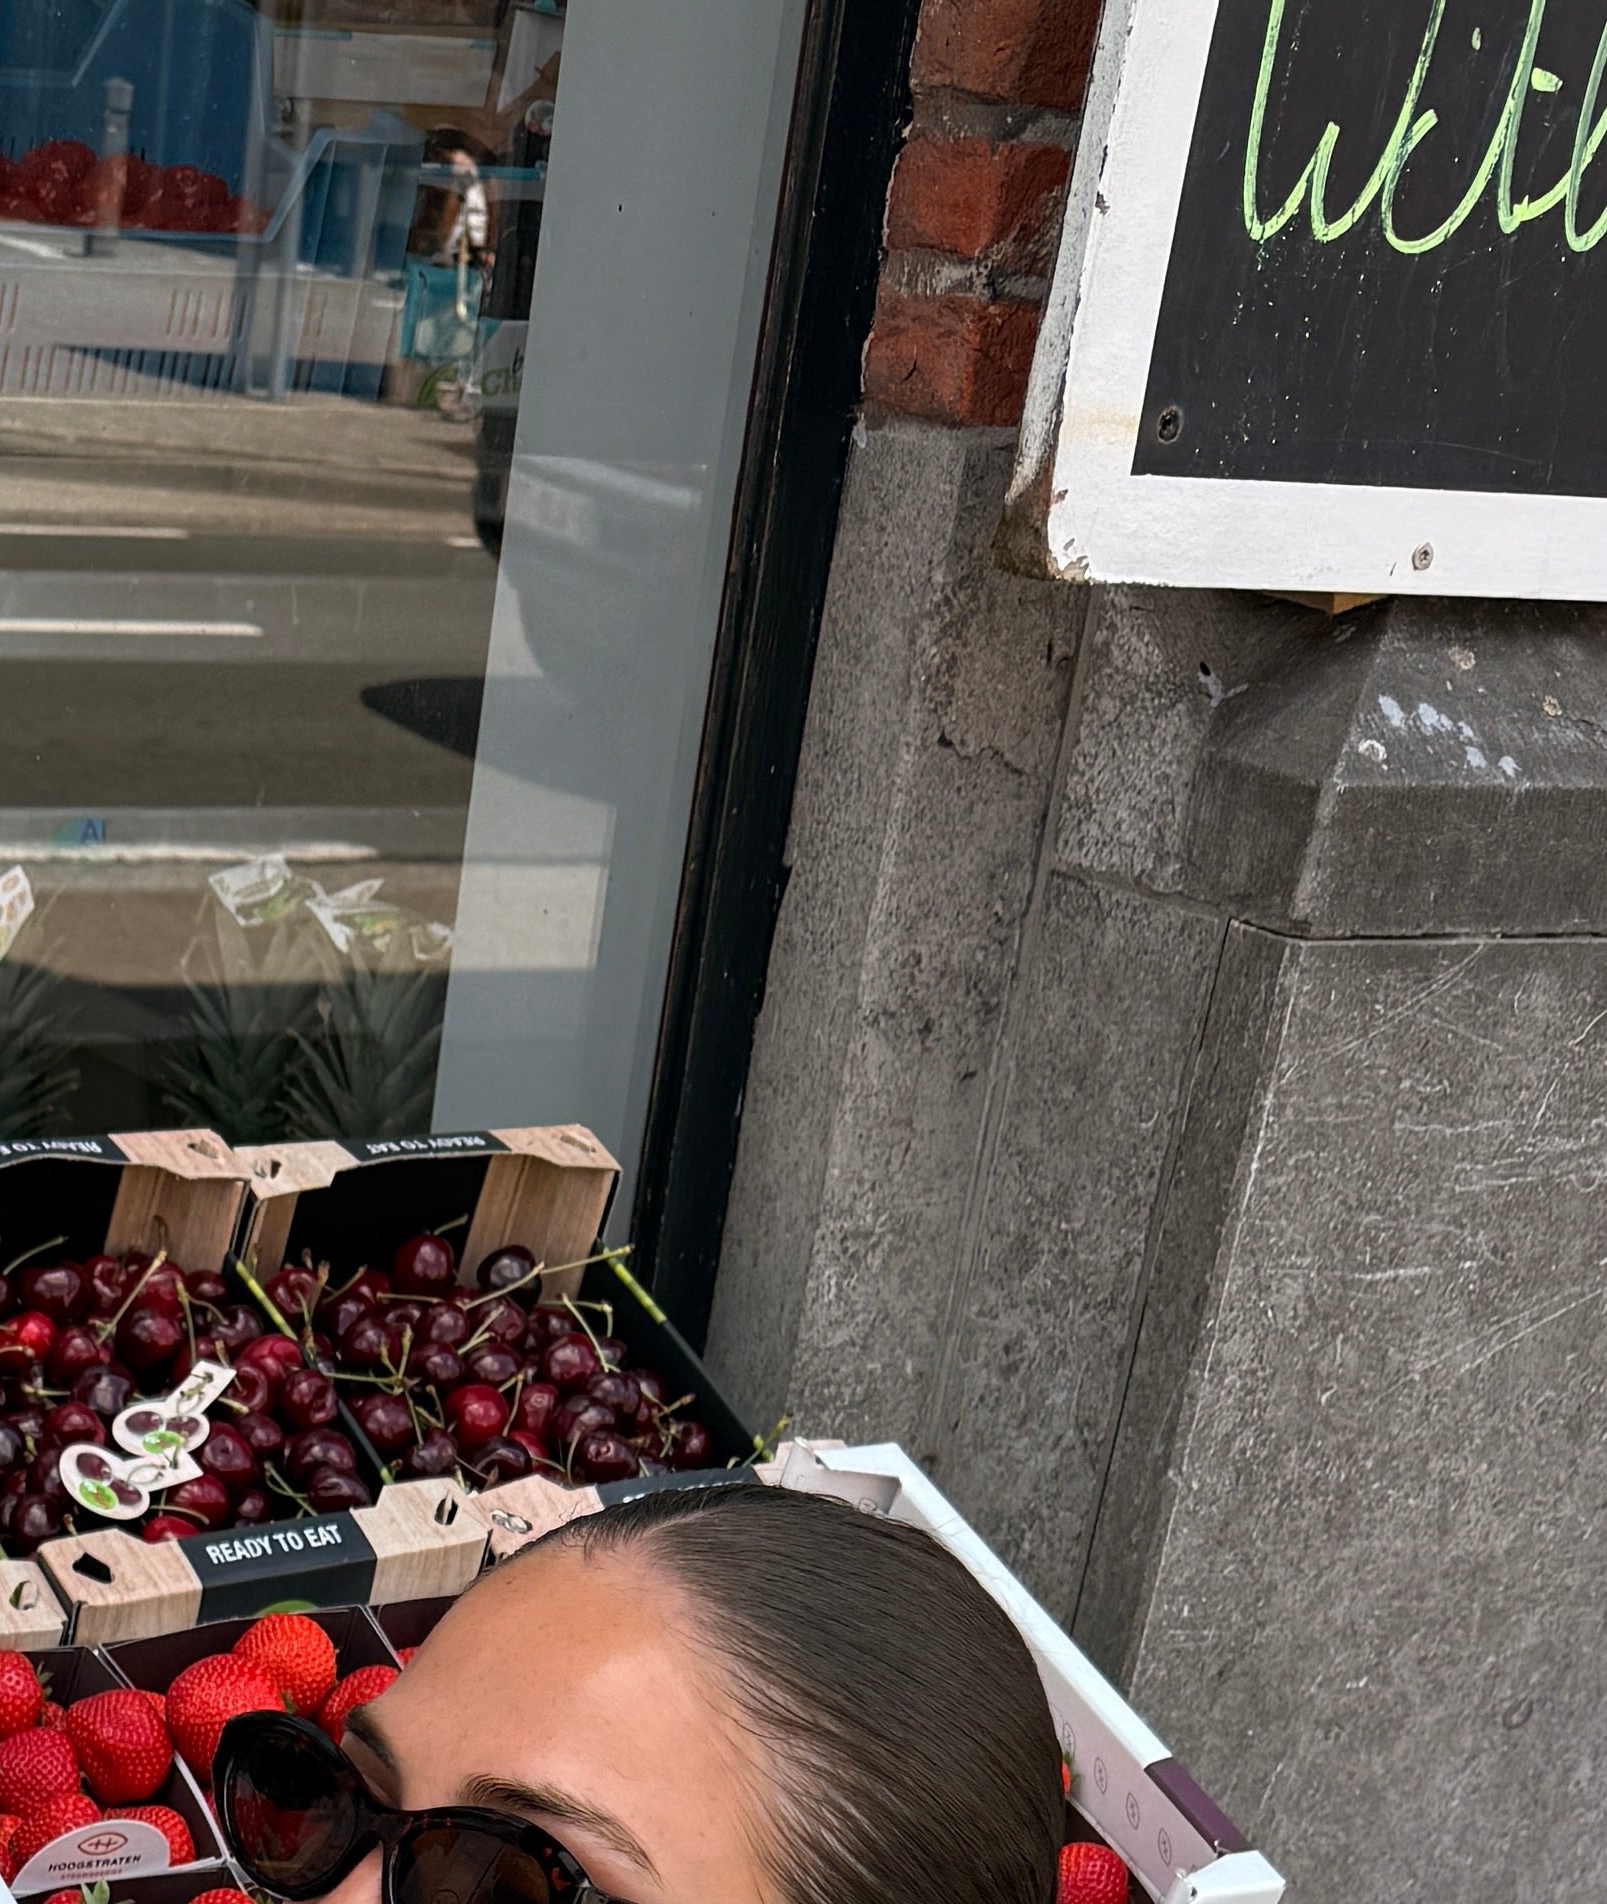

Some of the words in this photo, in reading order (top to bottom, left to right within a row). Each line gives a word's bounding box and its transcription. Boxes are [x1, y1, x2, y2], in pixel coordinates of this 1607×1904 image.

[205, 1535, 273, 1565] READY
[272, 1531, 305, 1553] TO
[303, 1524, 343, 1548] EAT
[47, 1853, 142, 1873] HOOGSTRATEN
